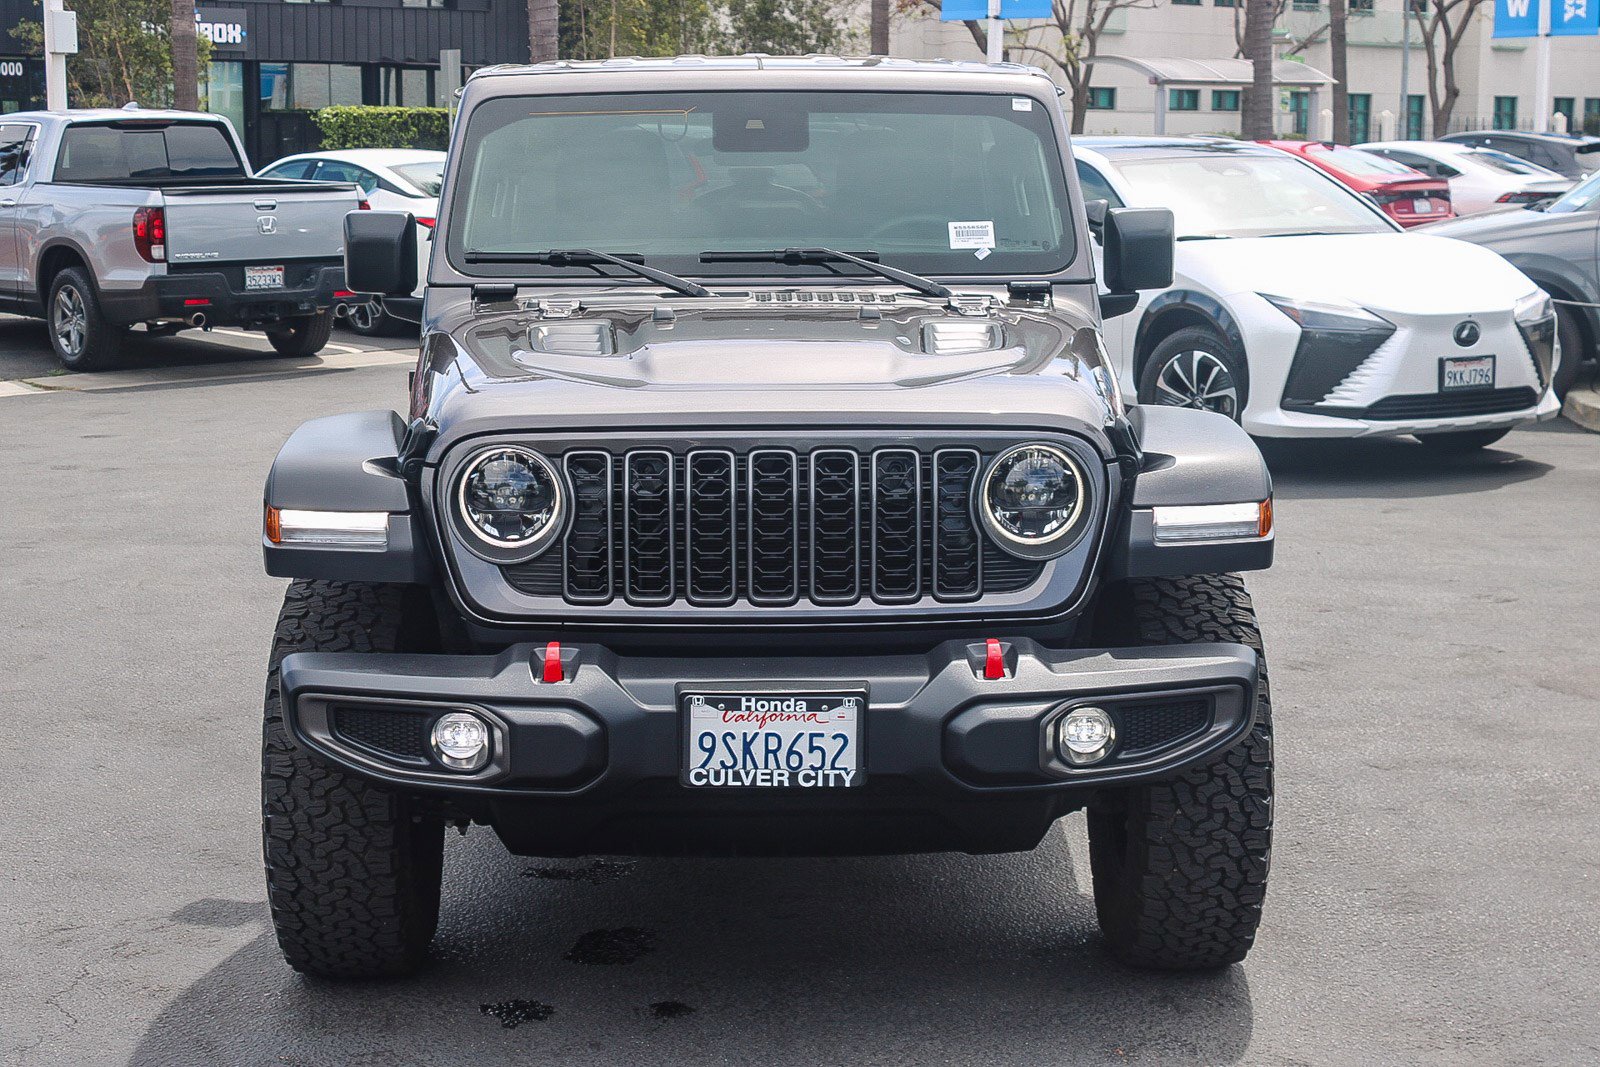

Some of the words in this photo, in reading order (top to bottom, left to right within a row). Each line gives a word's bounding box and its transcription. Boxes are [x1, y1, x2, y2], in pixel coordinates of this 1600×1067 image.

[1446, 368, 1491, 386] 9KKJ796
[741, 697, 807, 712] Honda
[722, 710, 829, 730] California
[698, 731, 850, 772] 9SKR652
[689, 768, 790, 787] CULVER
[798, 769, 857, 788] CITY
